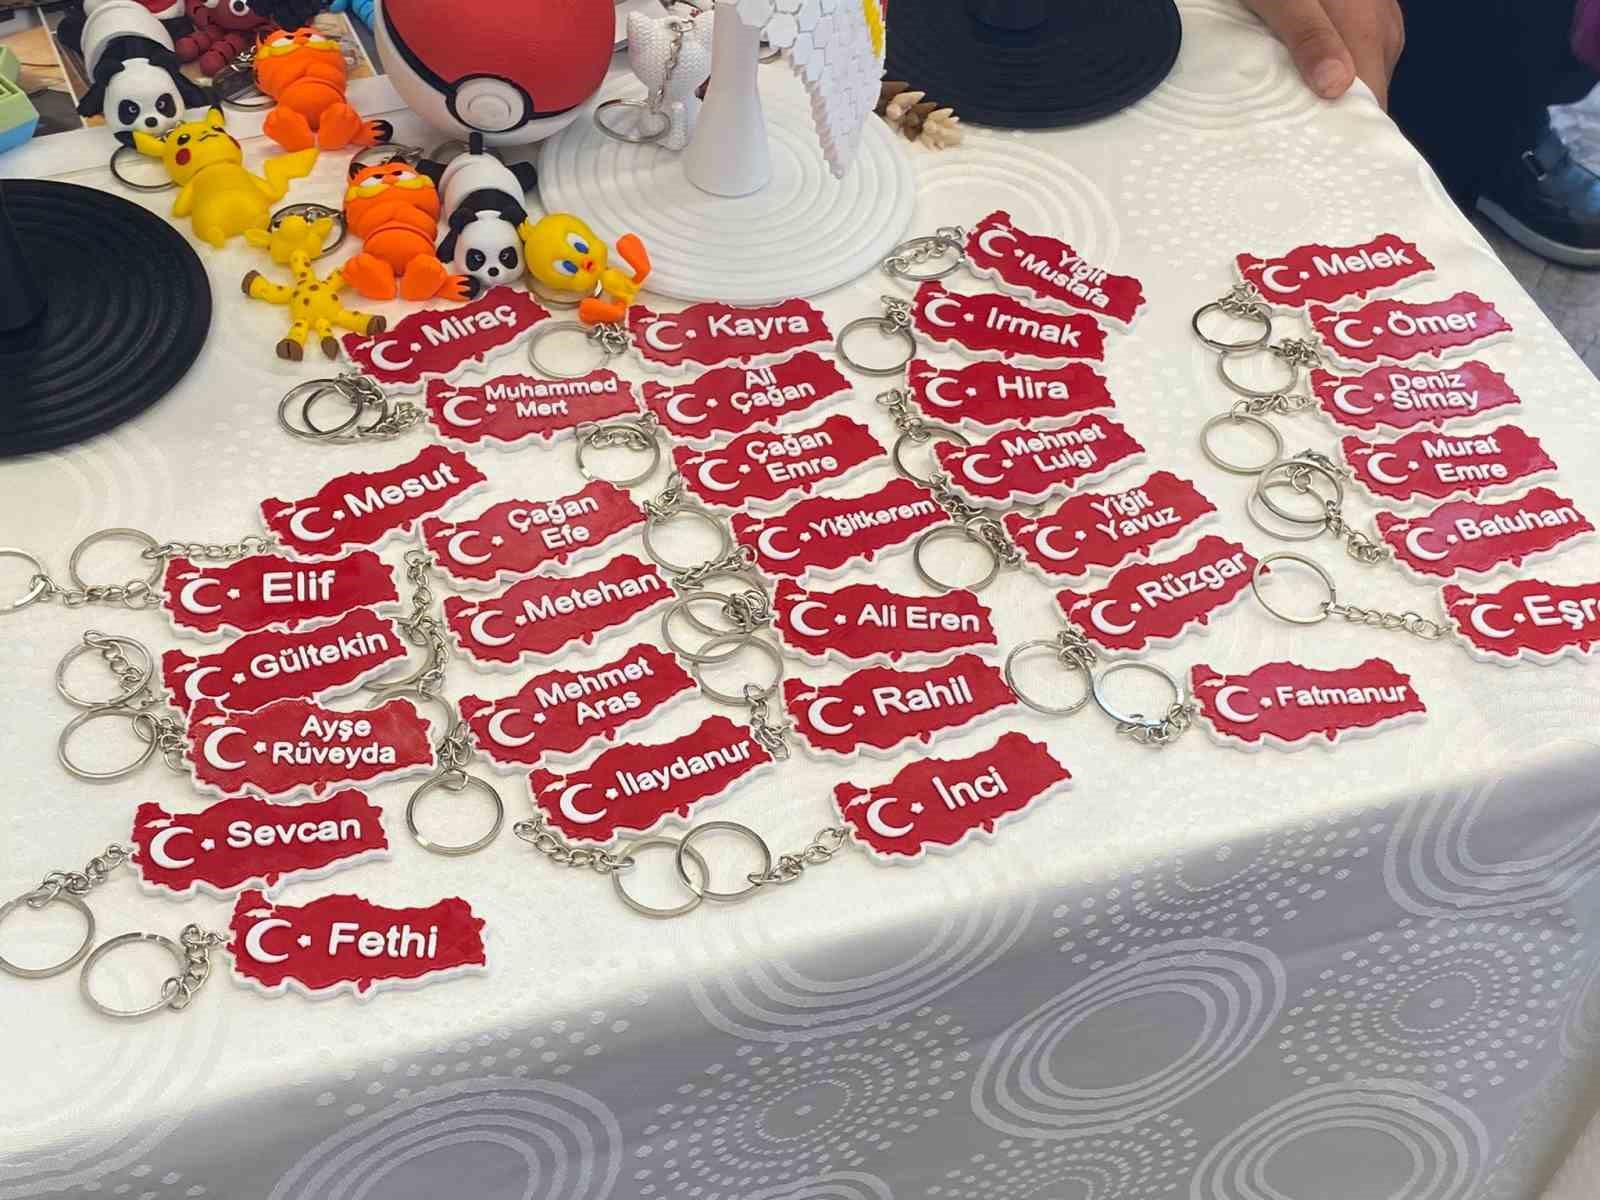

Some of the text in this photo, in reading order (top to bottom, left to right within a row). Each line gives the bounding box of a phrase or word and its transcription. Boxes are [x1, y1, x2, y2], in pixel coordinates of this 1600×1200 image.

[1312, 246, 1413, 277] Melek
[1018, 254, 1110, 308] Mustafa
[420, 304, 517, 347] Miraç
[707, 312, 809, 340] Kayra
[986, 308, 1082, 348] Irmak
[1387, 310, 1478, 336] Ömer
[484, 377, 617, 399] Muhammed
[730, 381, 816, 413] Çağan
[996, 376, 1069, 400] Hira
[1389, 372, 1466, 390] Deniz
[516, 401, 569, 417] Mert
[746, 429, 833, 462] Çağan
[1000, 422, 1107, 457] Mehmet
[1421, 436, 1502, 459] Murat
[765, 454, 838, 483] Emre
[1434, 462, 1508, 482] Emre
[343, 462, 460, 518] Mesut
[1090, 489, 1154, 519] Yiğit
[508, 497, 598, 532] Çağan
[809, 499, 936, 538] Yiğitkerem
[1096, 506, 1181, 541] Yavuz
[1455, 505, 1579, 541] Batuhan
[542, 523, 589, 549] Efe
[261, 570, 336, 603] Elif
[1136, 551, 1248, 607] Rüzgar
[523, 573, 661, 623] Metehan
[1522, 595, 1600, 631] Eşr
[857, 603, 980, 632] Ali Eren
[250, 631, 389, 679] Gültekin
[534, 656, 654, 708] Mehmet
[872, 675, 974, 716] Rahil
[1276, 682, 1407, 707] Fatmanur
[575, 689, 641, 726] Aras
[300, 716, 372, 742] Ayşe
[272, 742, 396, 769] Rüveyda
[226, 818, 361, 848] Sevcan
[328, 922, 438, 959] Fethi
